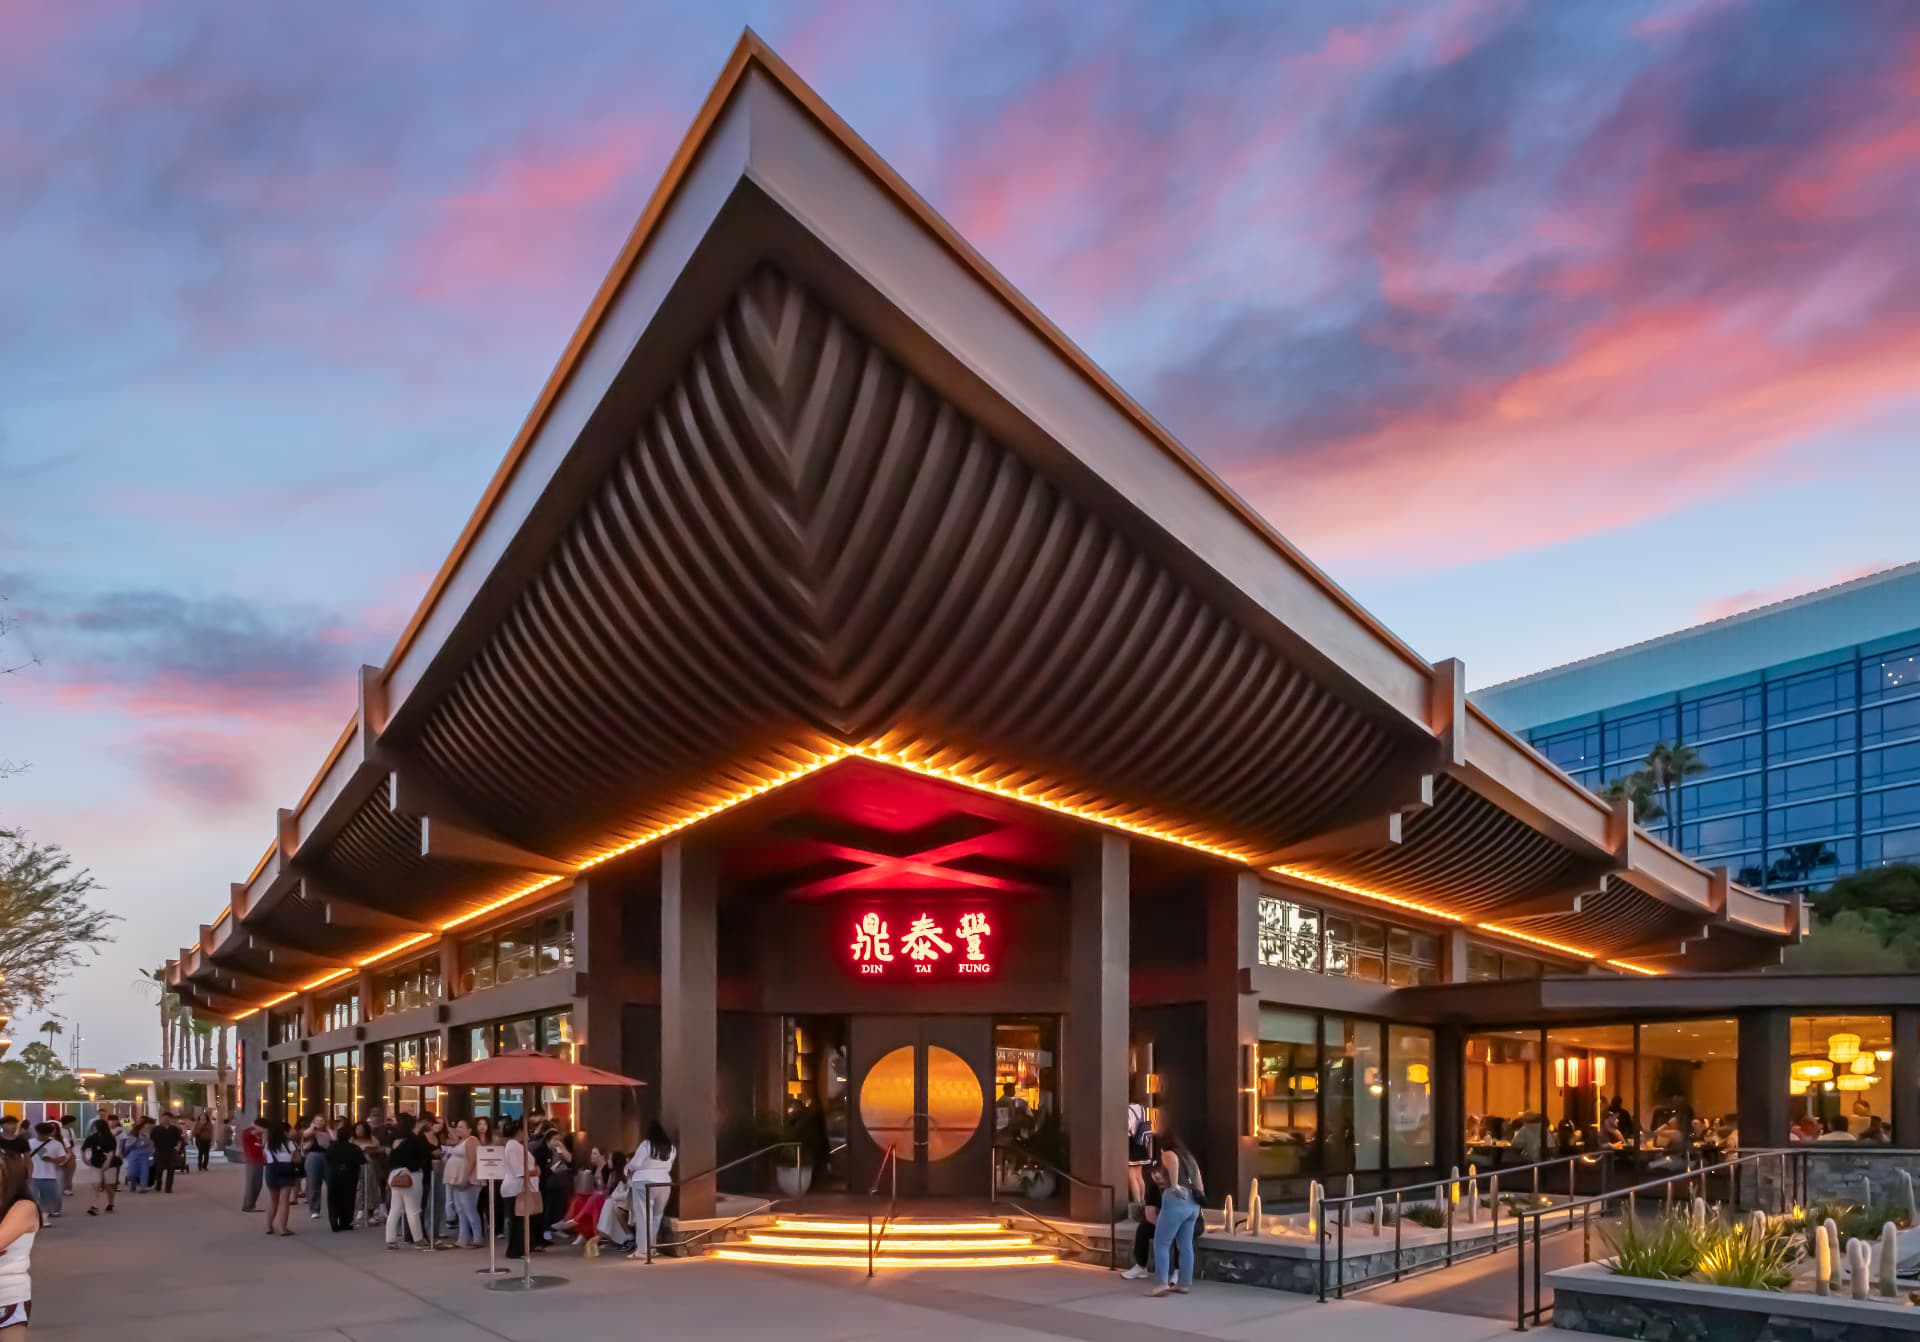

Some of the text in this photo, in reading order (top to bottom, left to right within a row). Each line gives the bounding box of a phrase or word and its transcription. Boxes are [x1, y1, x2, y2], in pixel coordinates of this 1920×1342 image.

[861, 963, 991, 974] DIN TAI FUNG
